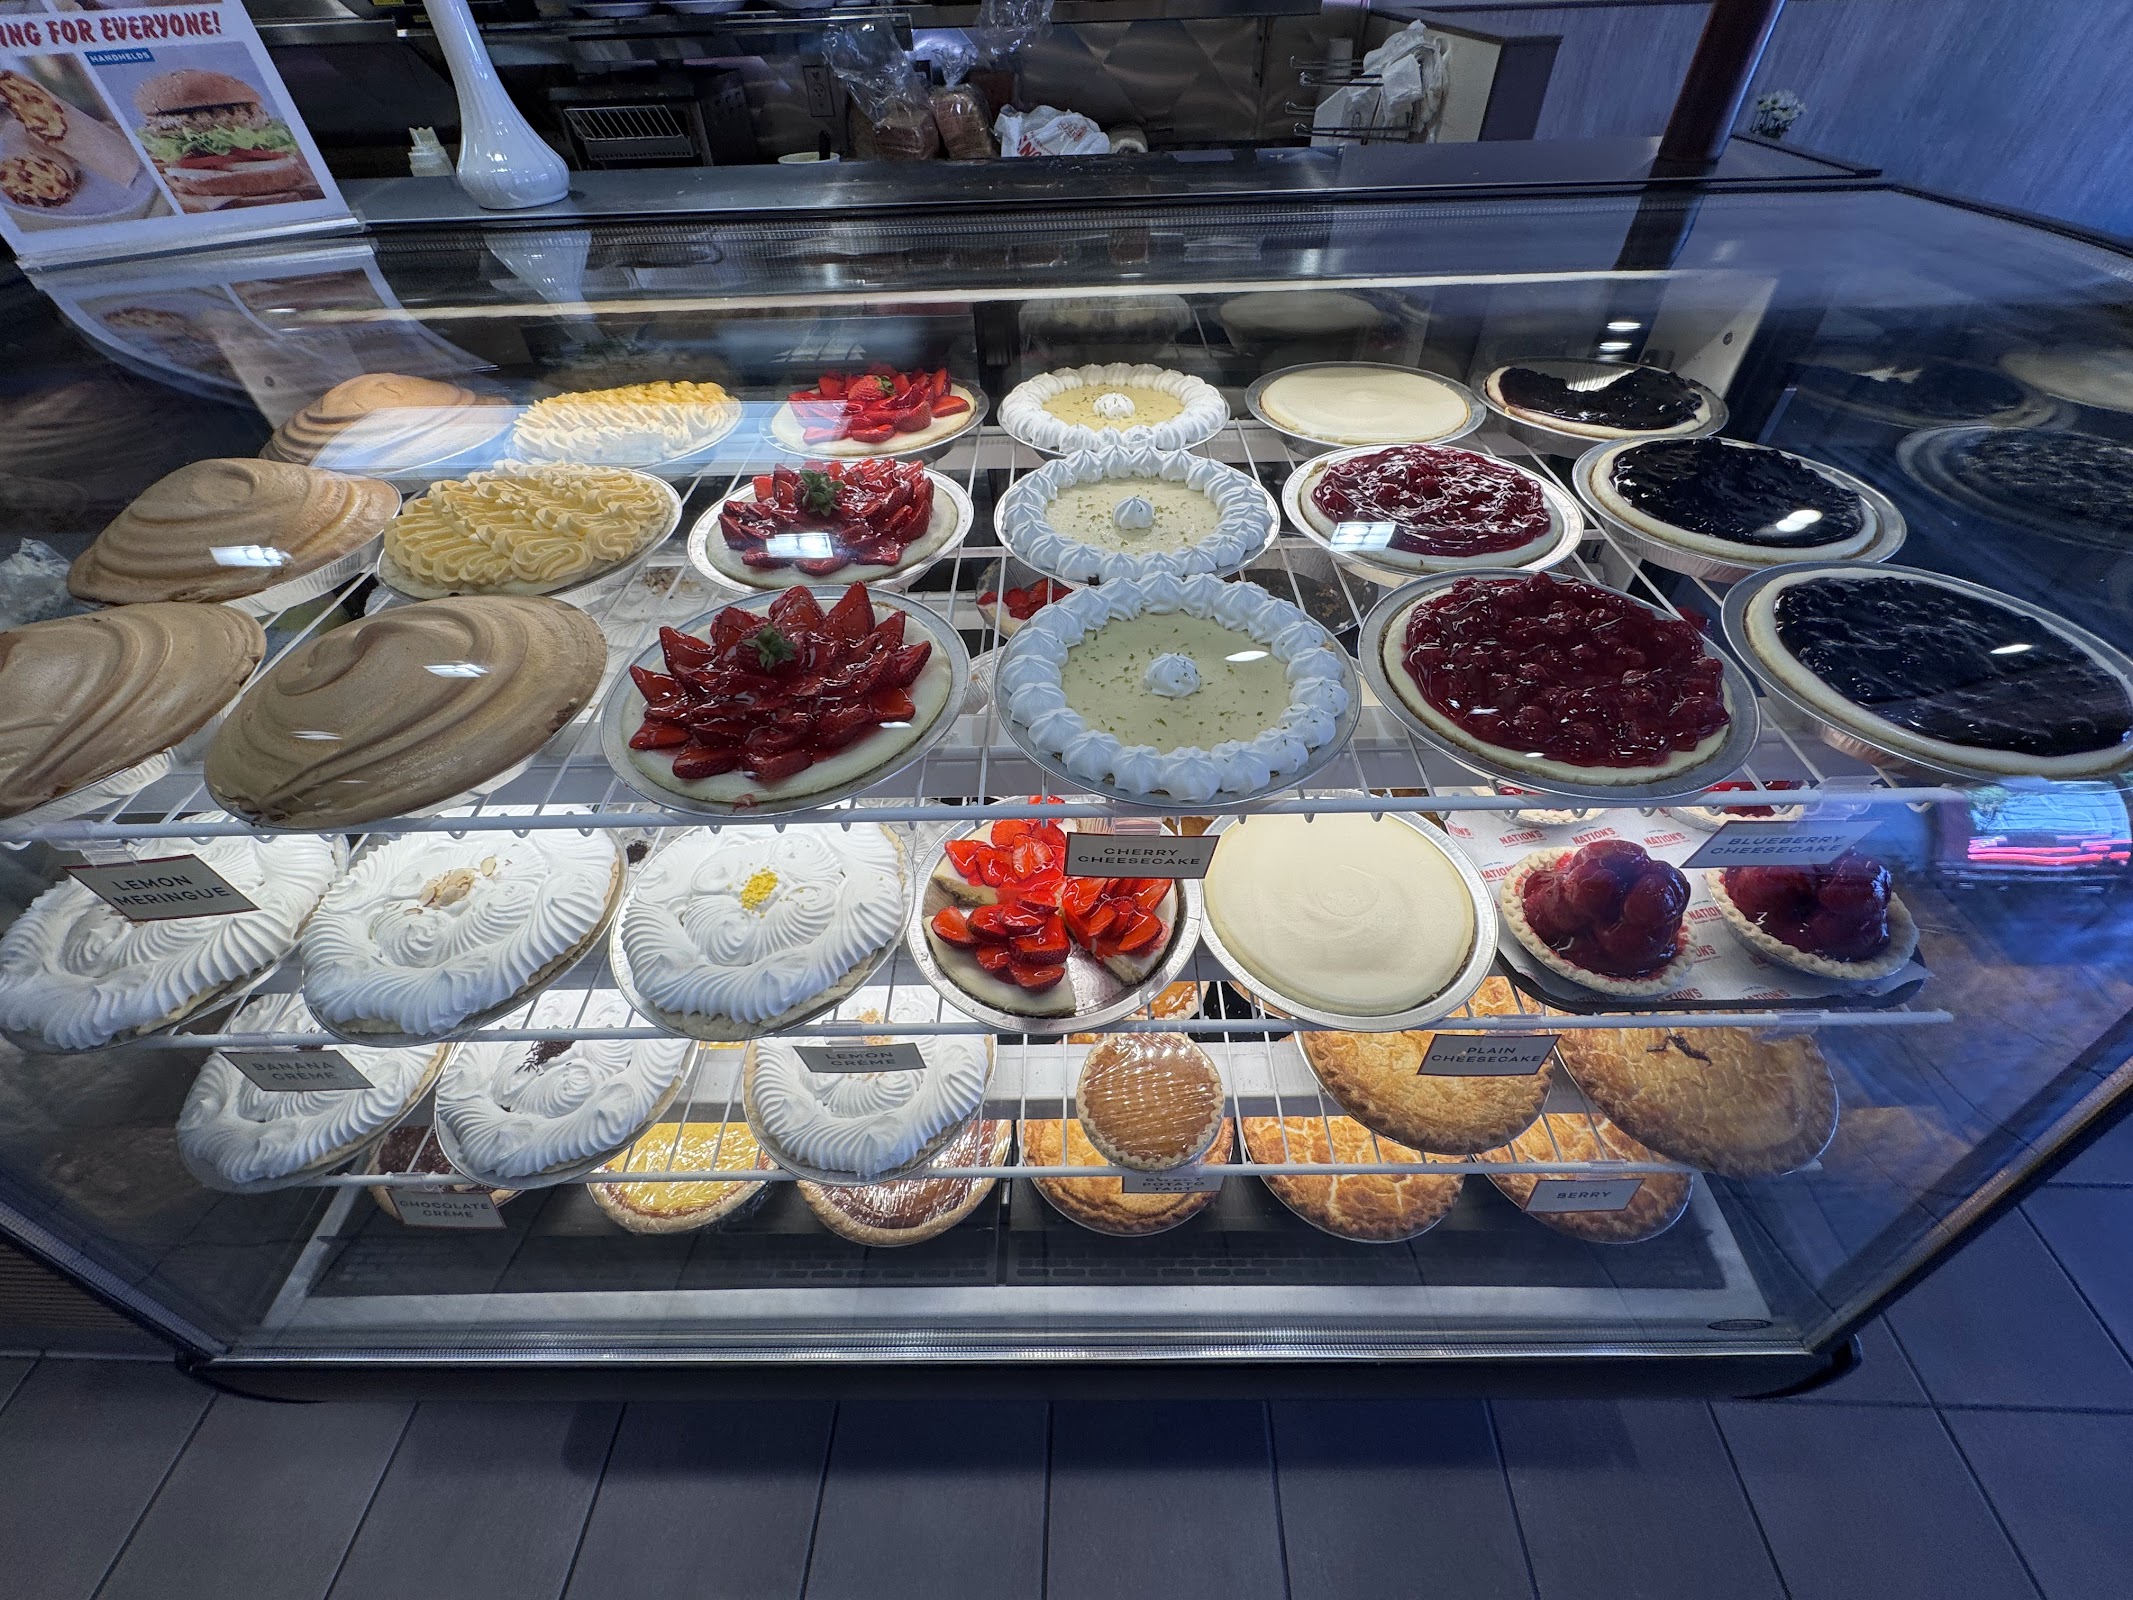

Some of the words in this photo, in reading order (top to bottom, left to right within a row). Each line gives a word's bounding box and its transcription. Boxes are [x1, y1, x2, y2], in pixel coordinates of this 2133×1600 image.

[46, 18, 98, 45] FOR
[99, 10, 223, 42] EVERYONE!
[90, 51, 150, 64] HANDHELDS
[1499, 829, 1543, 845] NATION'S
[1571, 827, 1616, 845] NATION'S
[1643, 831, 1686, 846] NATION'S
[1728, 835, 1846, 845] BLUEBERRY
[1103, 847, 1179, 856] CHERRY
[1710, 844, 1843, 855] CHEESECAKE
[1077, 855, 1201, 865] CHEESECAKE
[113, 874, 193, 891] LEMON
[113, 886, 231, 906] MERINGUE
[825, 1051, 893, 1060] LEMON
[1431, 1054, 1541, 1063] CHEESECAKE
[251, 1061, 336, 1071] BANANA
[1556, 1191, 1611, 1199] BERRY
[400, 1200, 490, 1210] CHOCOLATE
